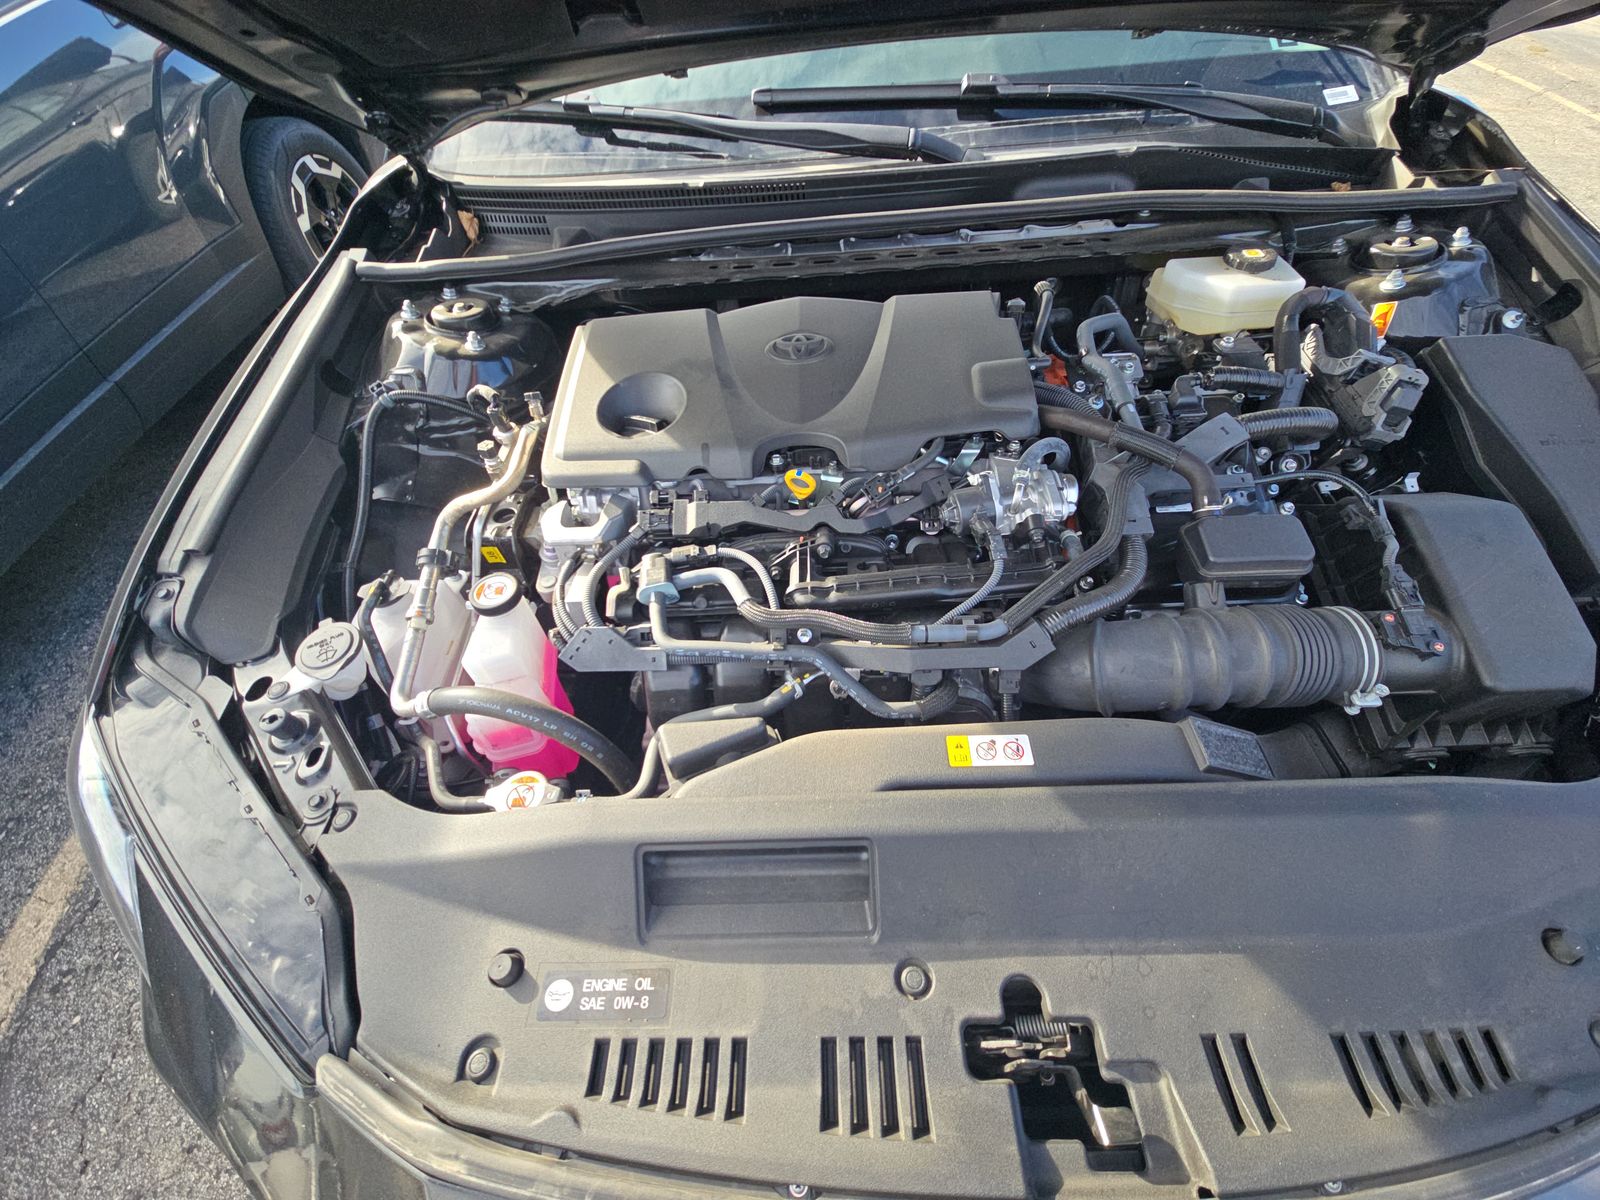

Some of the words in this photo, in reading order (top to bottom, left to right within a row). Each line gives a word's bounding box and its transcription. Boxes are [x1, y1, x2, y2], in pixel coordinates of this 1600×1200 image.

[505, 708, 540, 723] ACV17
[582, 978, 628, 992] ENGINE
[634, 977, 655, 991] OIL
[579, 997, 606, 1011] SAE
[613, 995, 649, 1010] 0W-8
